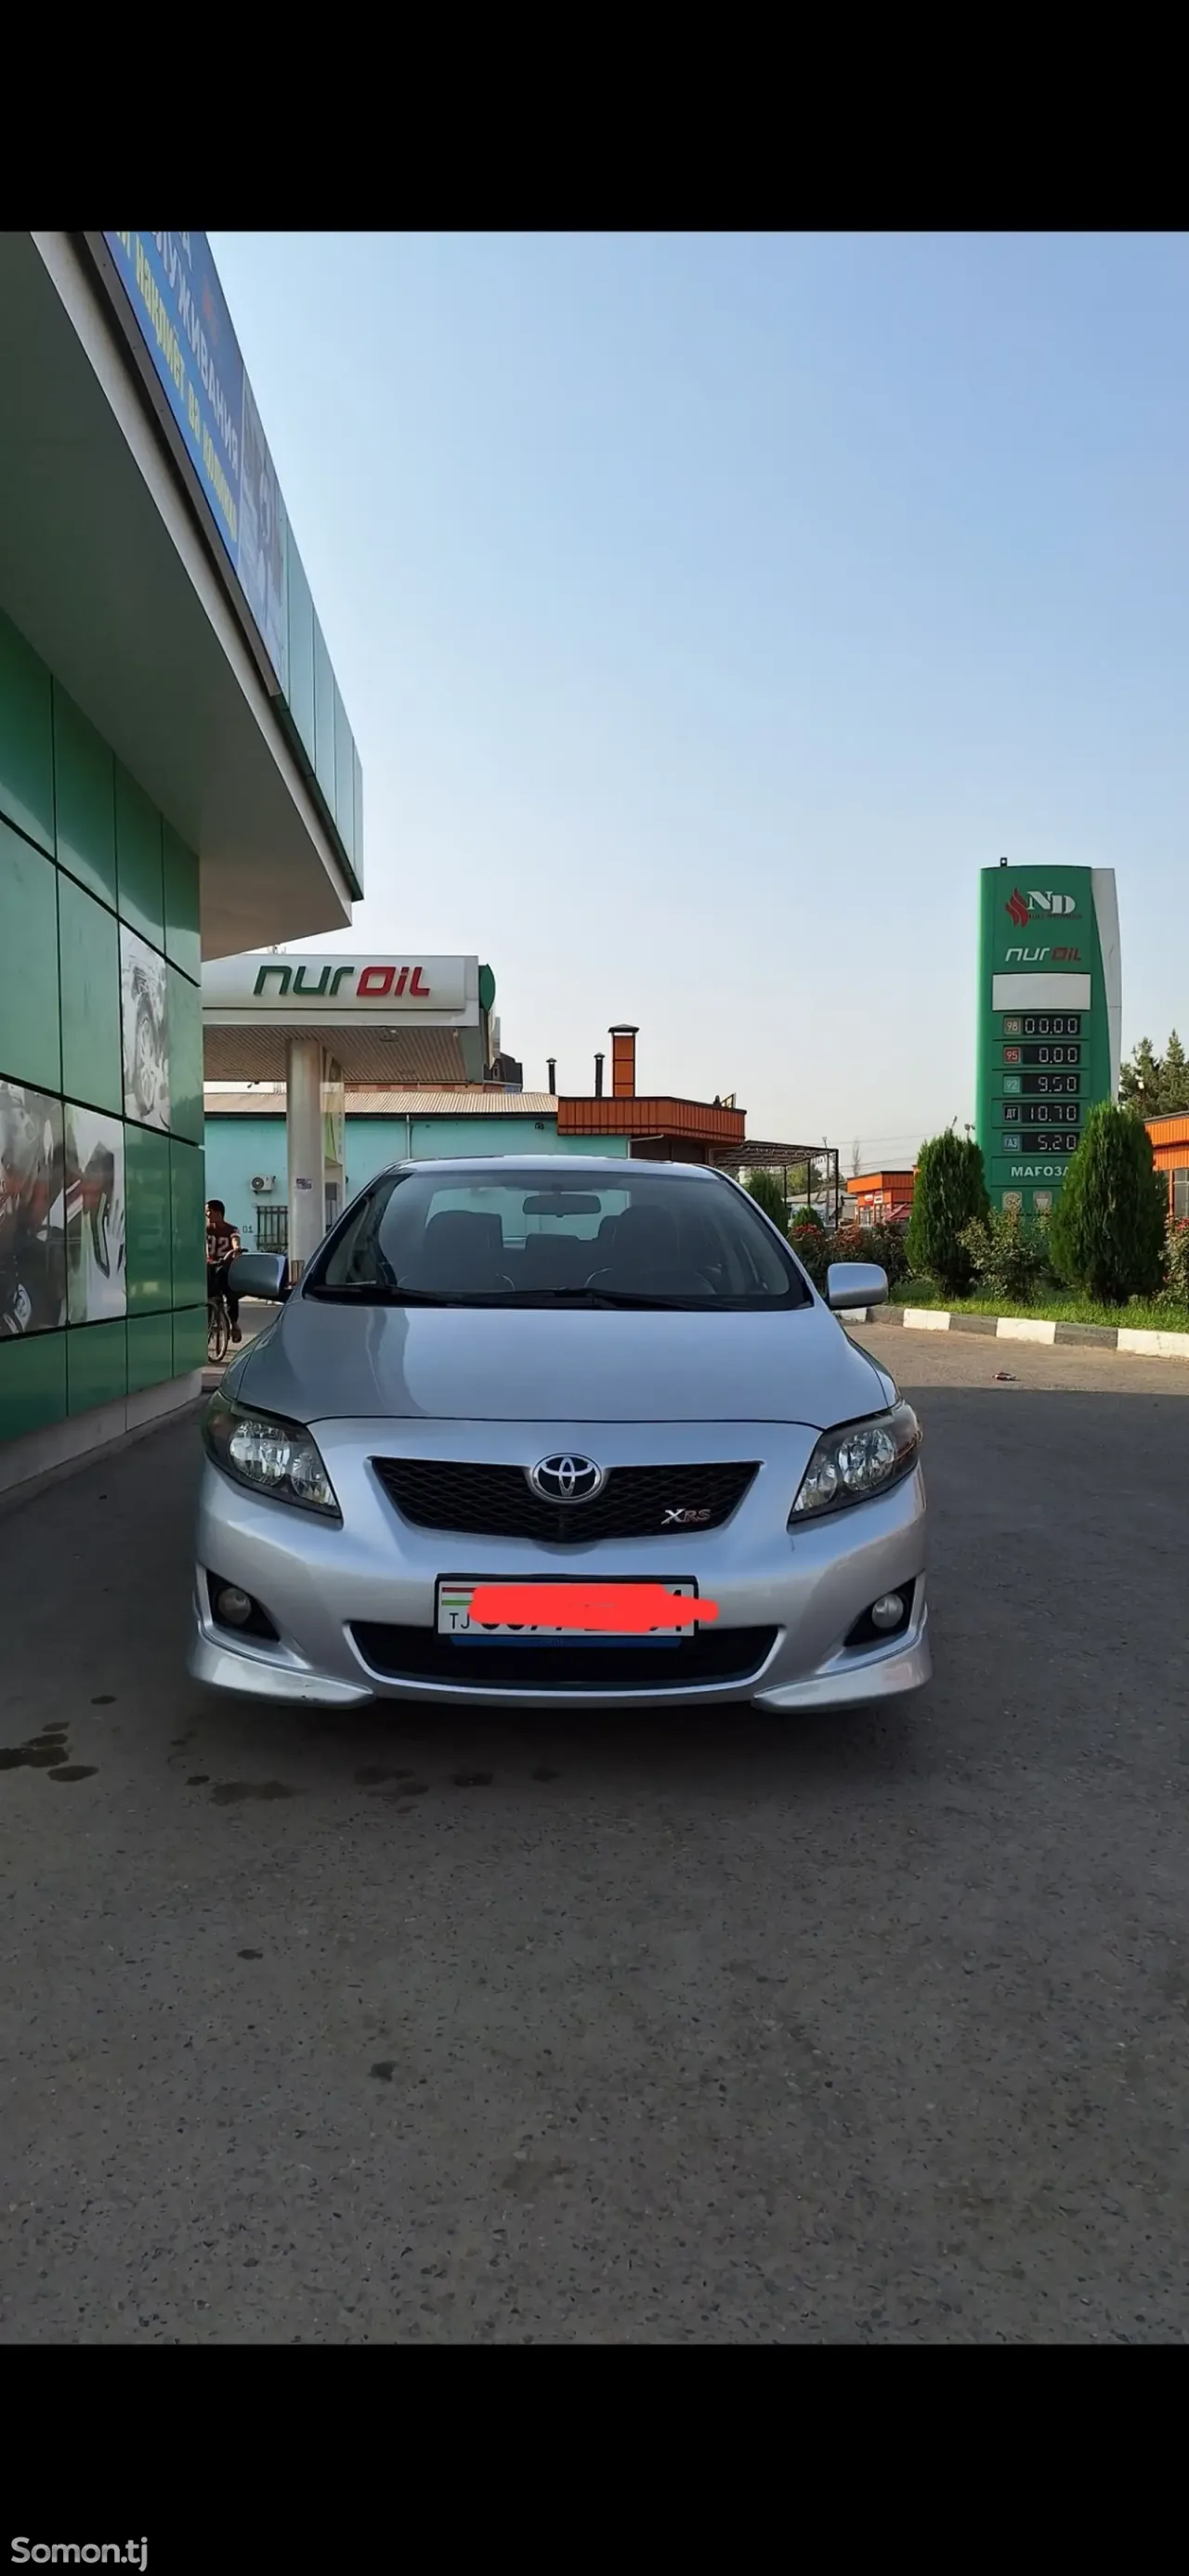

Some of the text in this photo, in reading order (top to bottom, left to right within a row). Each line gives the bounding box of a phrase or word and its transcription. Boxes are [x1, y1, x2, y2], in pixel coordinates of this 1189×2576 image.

[151, 231, 239, 480] ЛУЖИВАНИЯ
[1026, 891, 1077, 915] ND
[1006, 1018, 1078, 1034] 98 00.00
[1006, 1047, 1078, 1063] 95 0.00
[1006, 1076, 1078, 1093] 92 9.50
[1005, 1105, 1078, 1122] ДТ 10.70
[1005, 1135, 1077, 1151] ГАЗ 5.20
[660, 1508, 712, 1525] XRS
[449, 1612, 470, 1630] TJ
